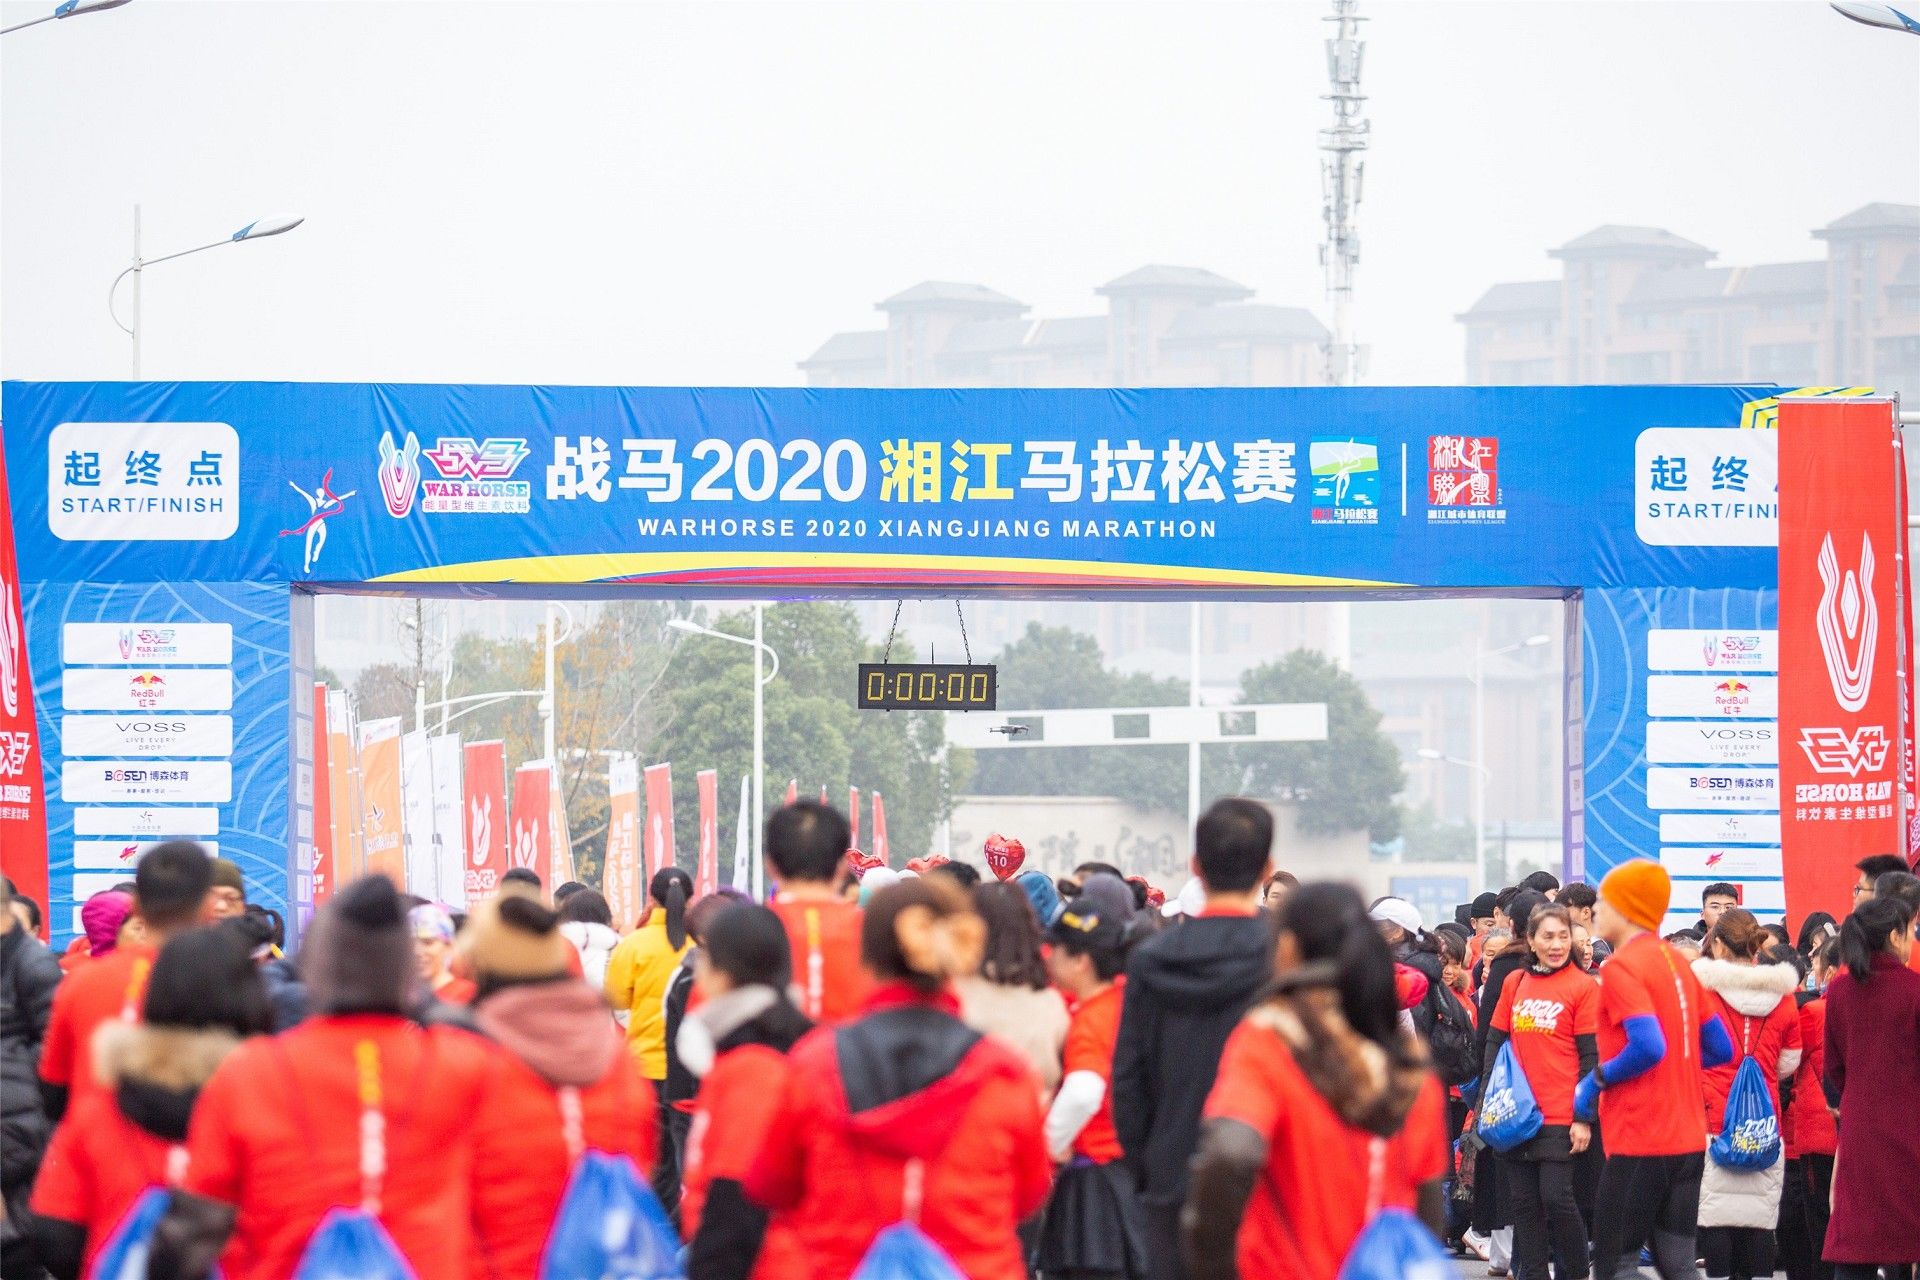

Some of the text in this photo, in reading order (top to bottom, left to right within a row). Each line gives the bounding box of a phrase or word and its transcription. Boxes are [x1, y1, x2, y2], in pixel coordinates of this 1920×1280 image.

[64, 450, 223, 488] 起终点
[546, 435, 1297, 504] 战马2020湘江马拉松赛
[1650, 455, 1778, 492] 起终
[424, 483, 528, 497] WAR HORSE
[62, 497, 223, 514] START/FINISH
[424, 499, 528, 512] 能量型维生素饮料
[638, 518, 1217, 538] WARHORSE 2020 XIANGJIANG MARATHON
[130, 689, 165, 698] RedBull
[867, 672, 988, 702] 0:00:00
[138, 698, 157, 708] 红牛
[1715, 696, 1749, 705] RedBull
[116, 722, 186, 733] VOSS
[1700, 729, 1772, 740] VOSS
[149, 770, 190, 782] 博森体育
[1734, 777, 1775, 789] 博森体育
